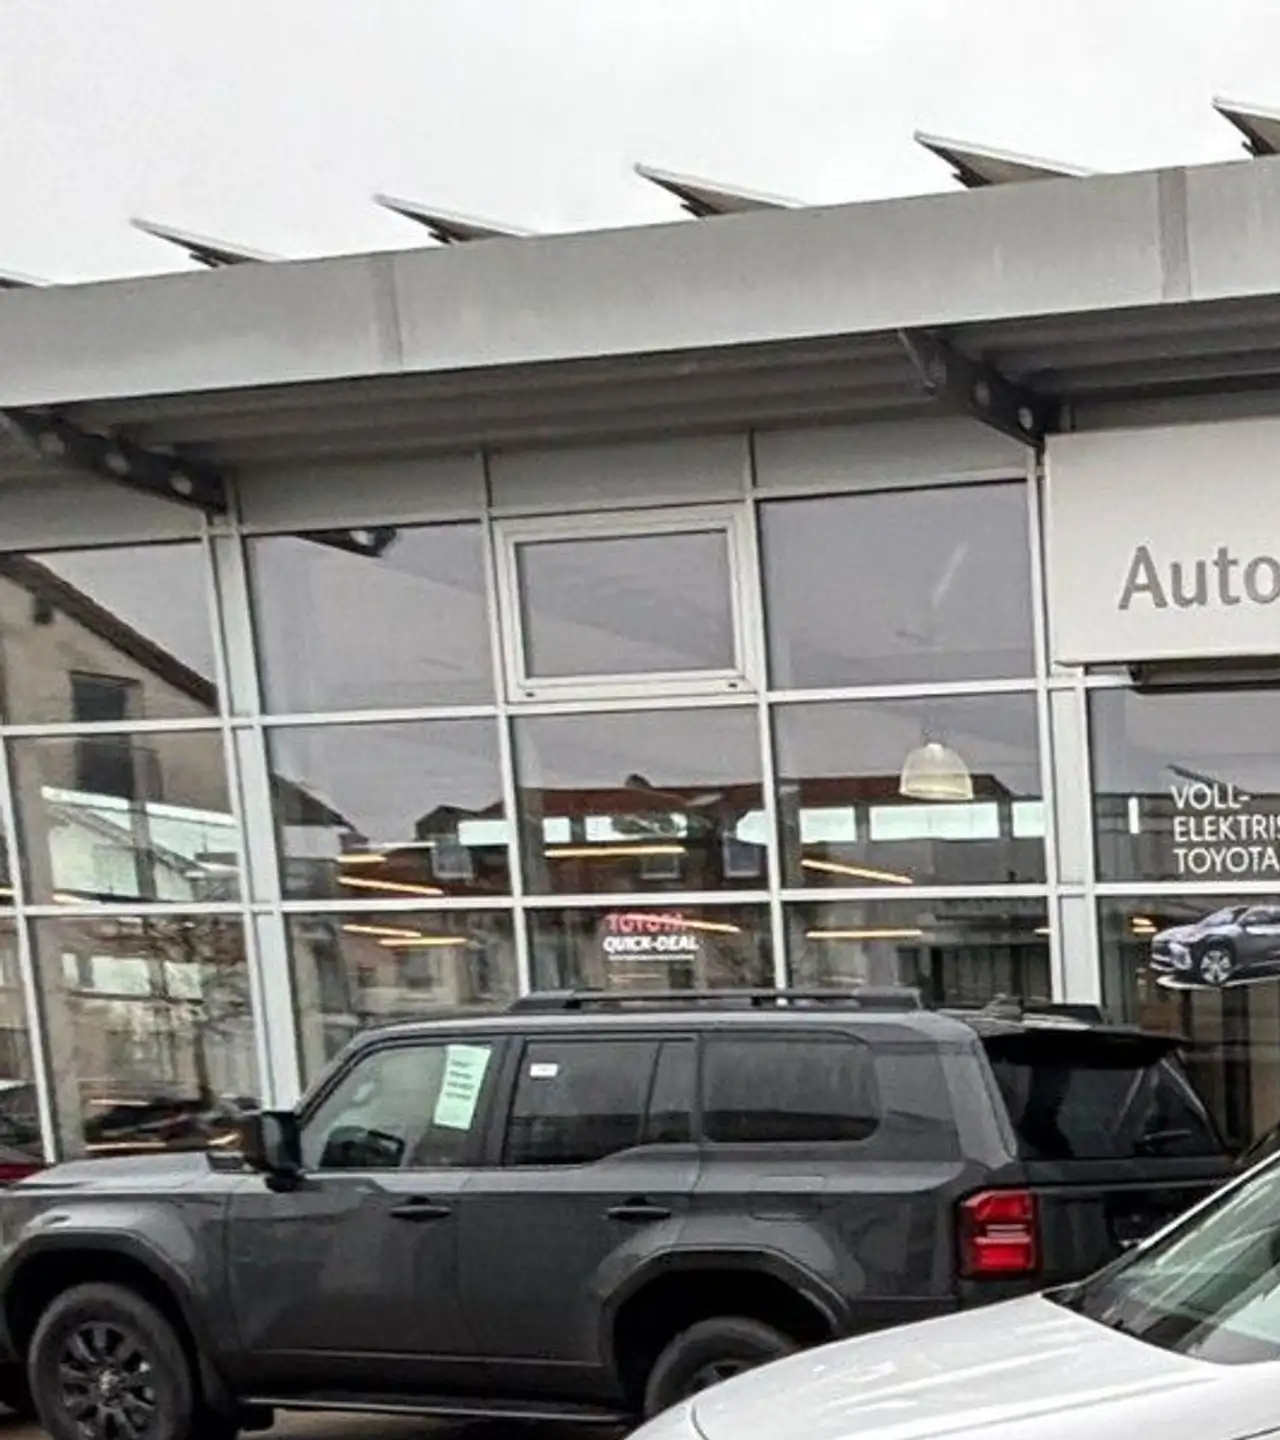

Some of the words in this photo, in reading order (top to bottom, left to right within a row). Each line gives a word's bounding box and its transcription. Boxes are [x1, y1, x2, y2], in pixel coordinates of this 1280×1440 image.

[1170, 782, 1249, 810] VOLL-
[1174, 847, 1280, 874] TOYOTA
[603, 935, 700, 953] QUICK-DEAL
